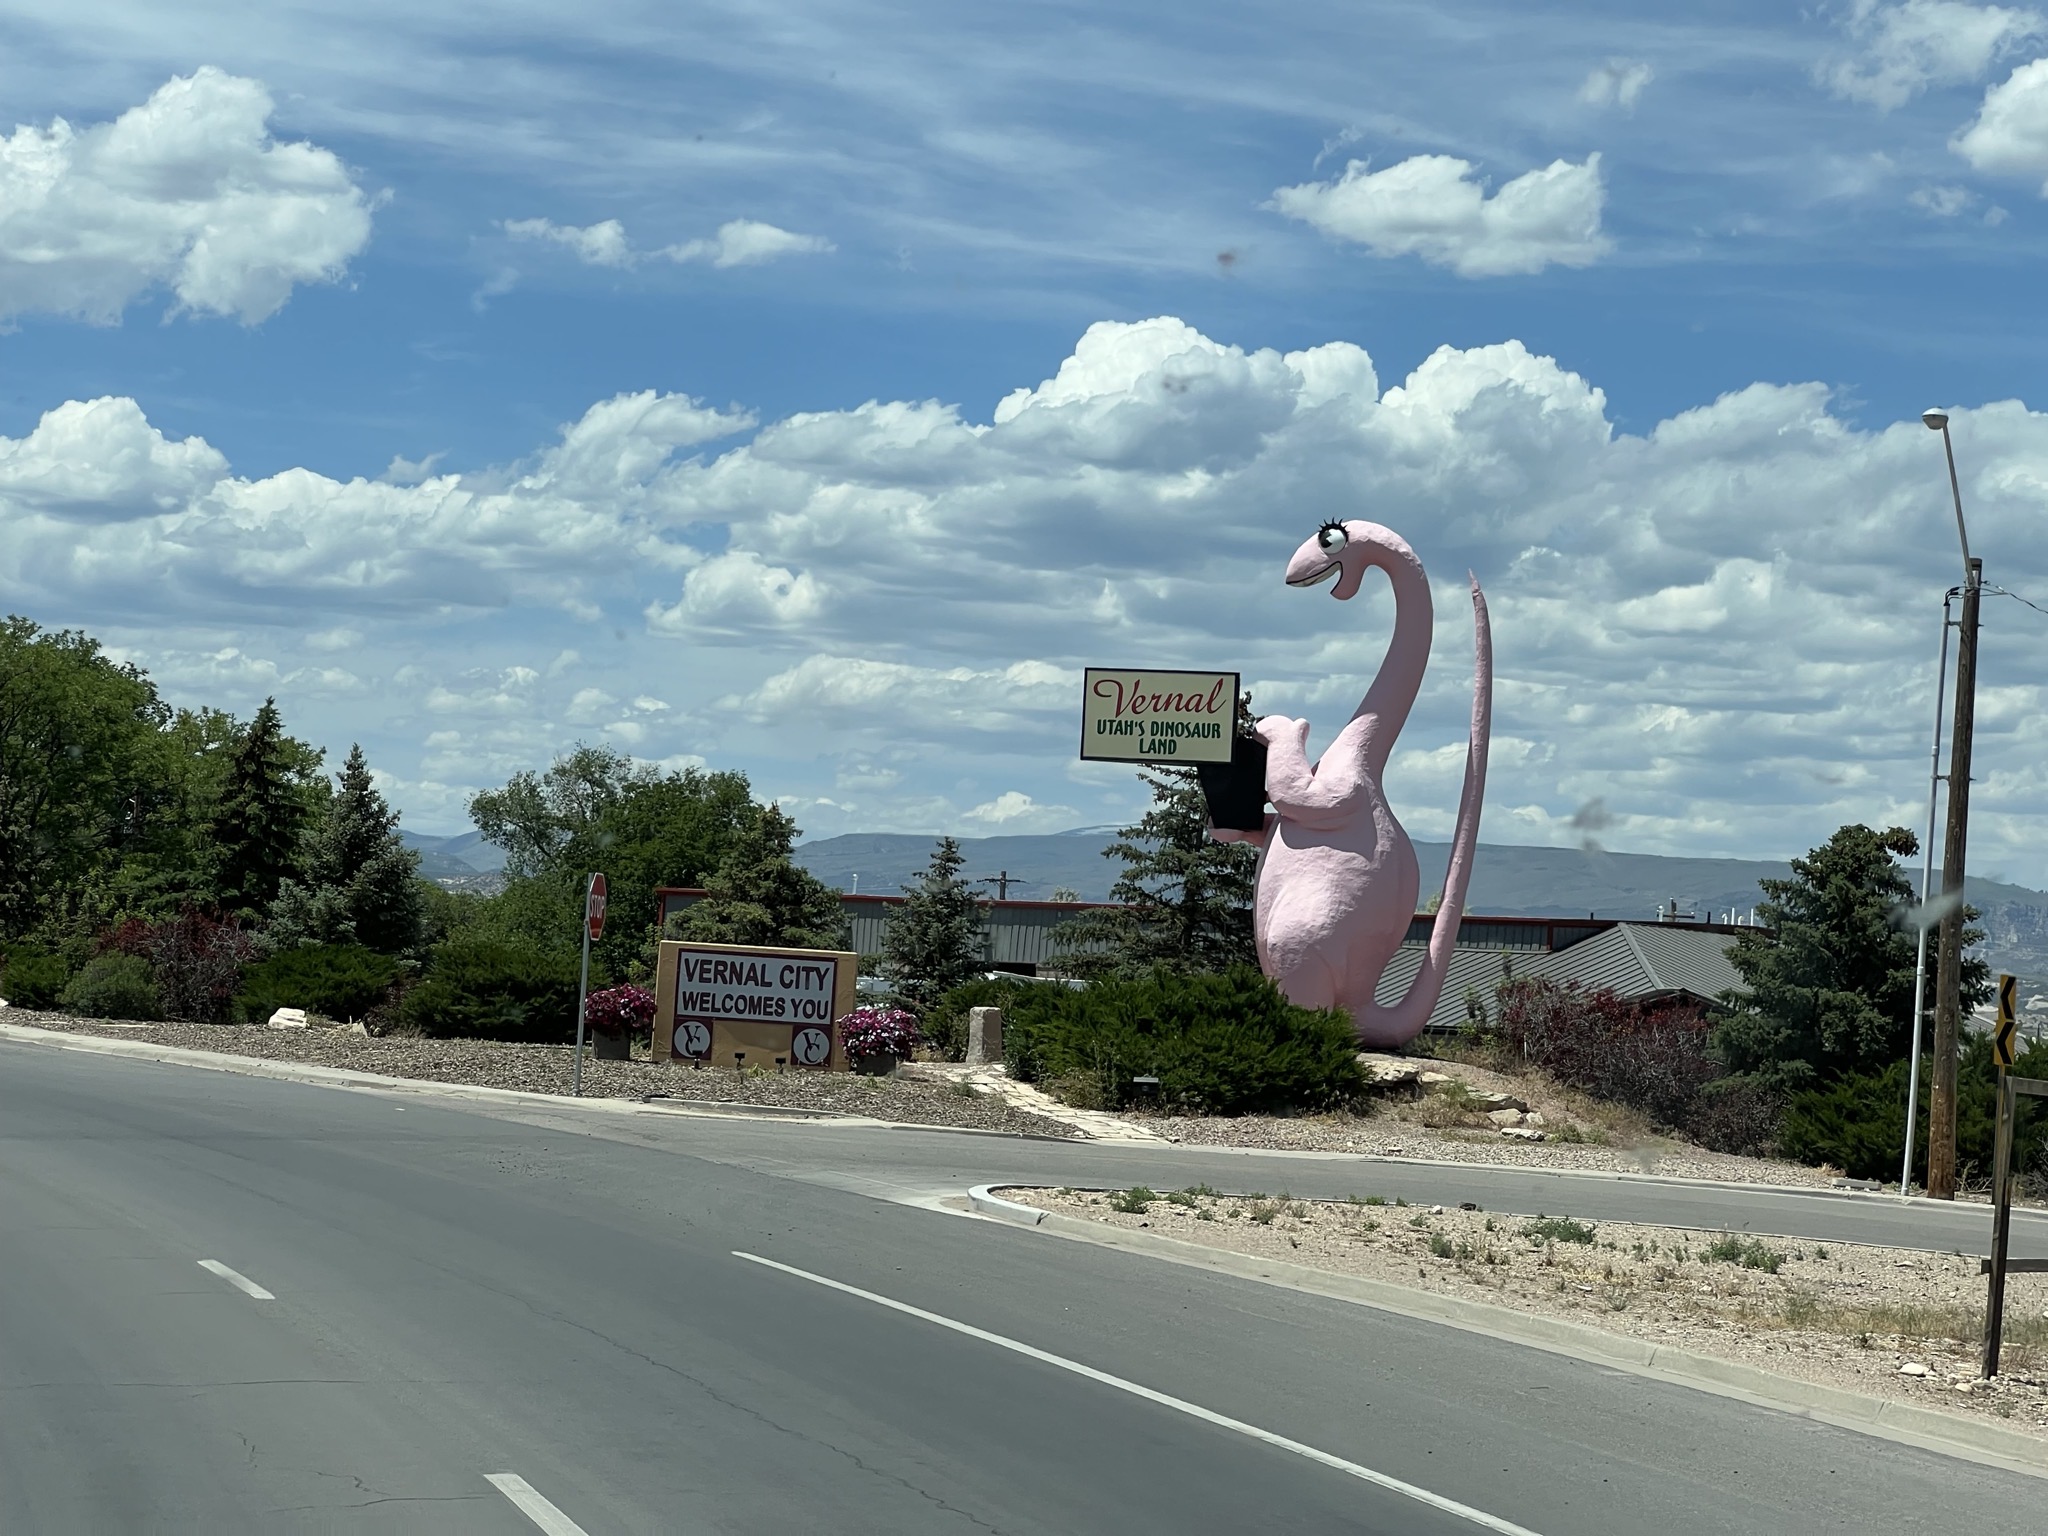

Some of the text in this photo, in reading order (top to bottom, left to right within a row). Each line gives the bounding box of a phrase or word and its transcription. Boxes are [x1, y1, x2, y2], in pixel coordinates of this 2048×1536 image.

[1093, 677, 1226, 718] Vernal
[1097, 719, 1221, 738] UTAH'S DINOSAUR
[1139, 738, 1177, 755] LAND
[590, 894, 605, 919] STOP
[684, 957, 830, 991] VERNAL CITY
[682, 990, 829, 1020] WELCOMES YOU
